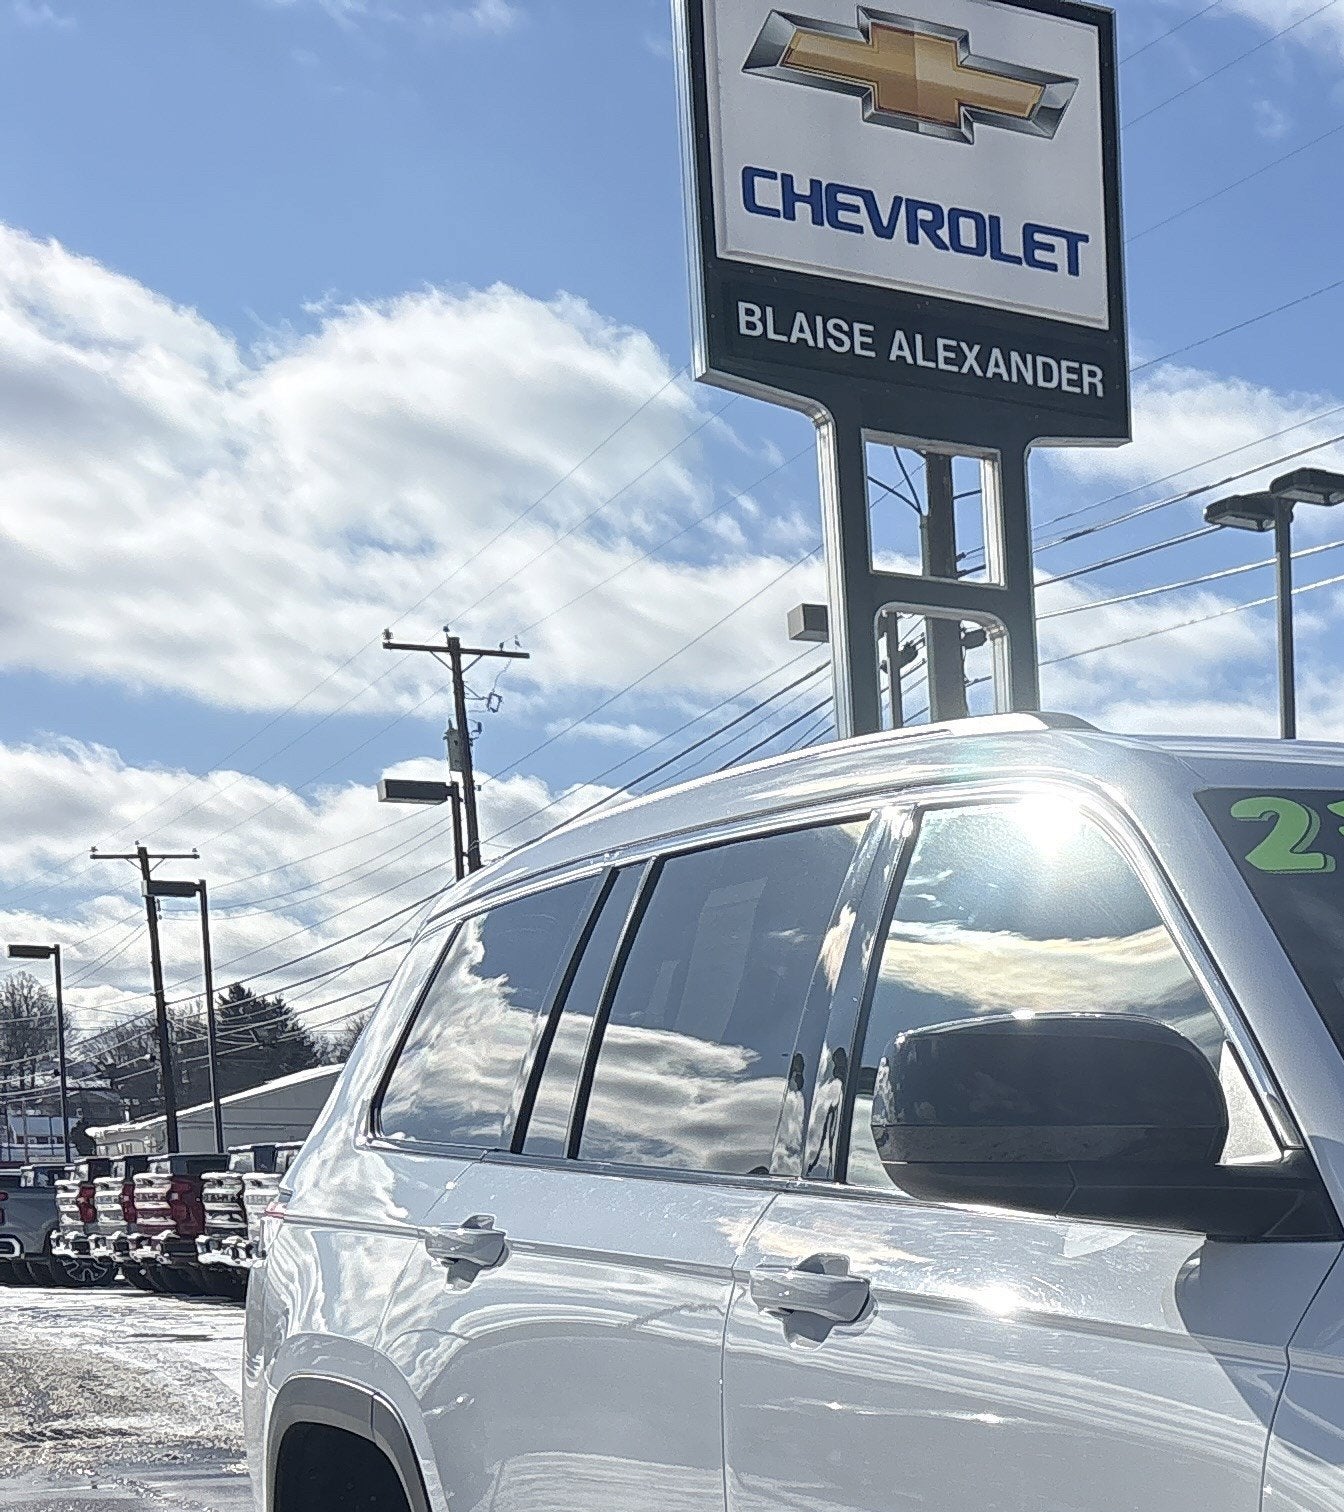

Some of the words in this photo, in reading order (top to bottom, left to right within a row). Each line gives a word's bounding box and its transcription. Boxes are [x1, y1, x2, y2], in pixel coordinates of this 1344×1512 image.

[741, 165, 1090, 277] CHEVROLET
[737, 300, 876, 359] BLAISE
[888, 330, 1105, 398] ALEXANDER
